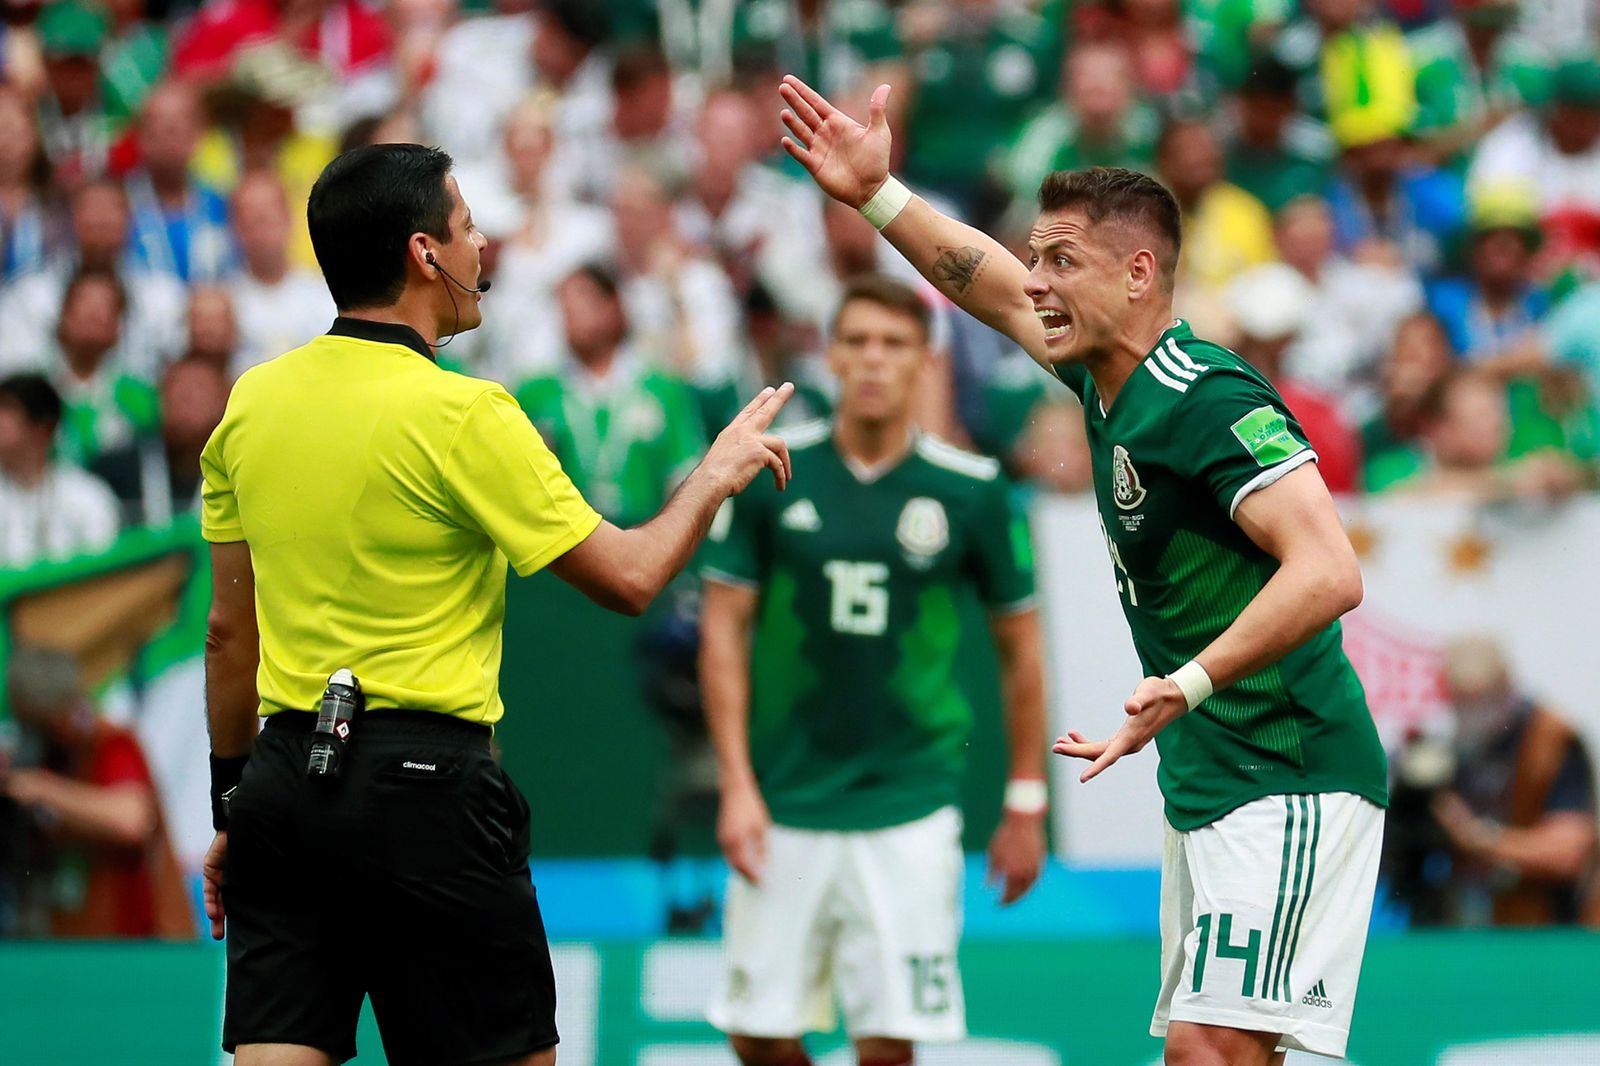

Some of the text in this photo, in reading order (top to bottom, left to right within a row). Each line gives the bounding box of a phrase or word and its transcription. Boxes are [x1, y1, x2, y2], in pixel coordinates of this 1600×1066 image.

[822, 560, 890, 636] 15
[402, 761, 436, 771] climacool
[903, 953, 950, 1014] 15
[1191, 913, 1262, 998] 14
[1301, 995, 1333, 1009] adidas
